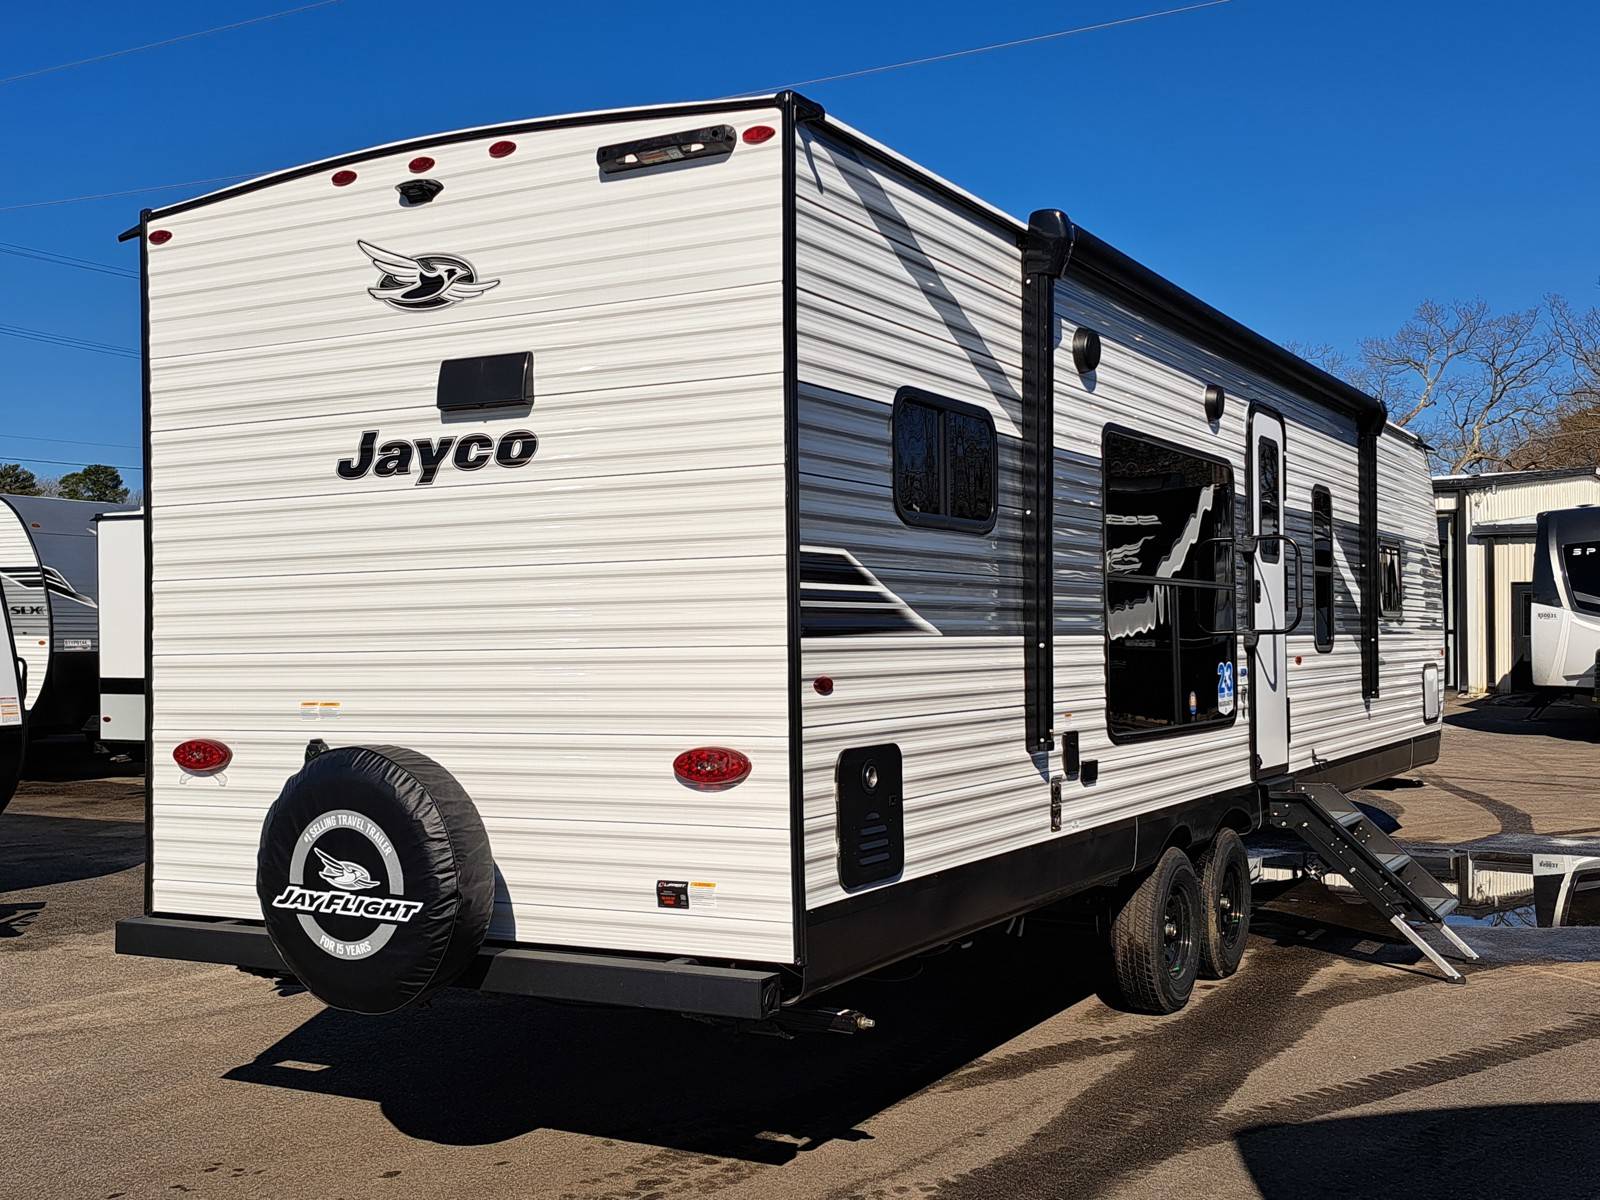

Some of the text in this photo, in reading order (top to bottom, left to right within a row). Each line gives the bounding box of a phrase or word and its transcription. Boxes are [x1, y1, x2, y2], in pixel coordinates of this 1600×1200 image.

[336, 429, 539, 486] Jayco
[309, 815, 337, 838] SELLING
[337, 814, 364, 831] TRAVEL
[365, 822, 393, 857] TRAILER
[319, 934, 372, 956] FOR 15 YEARS
